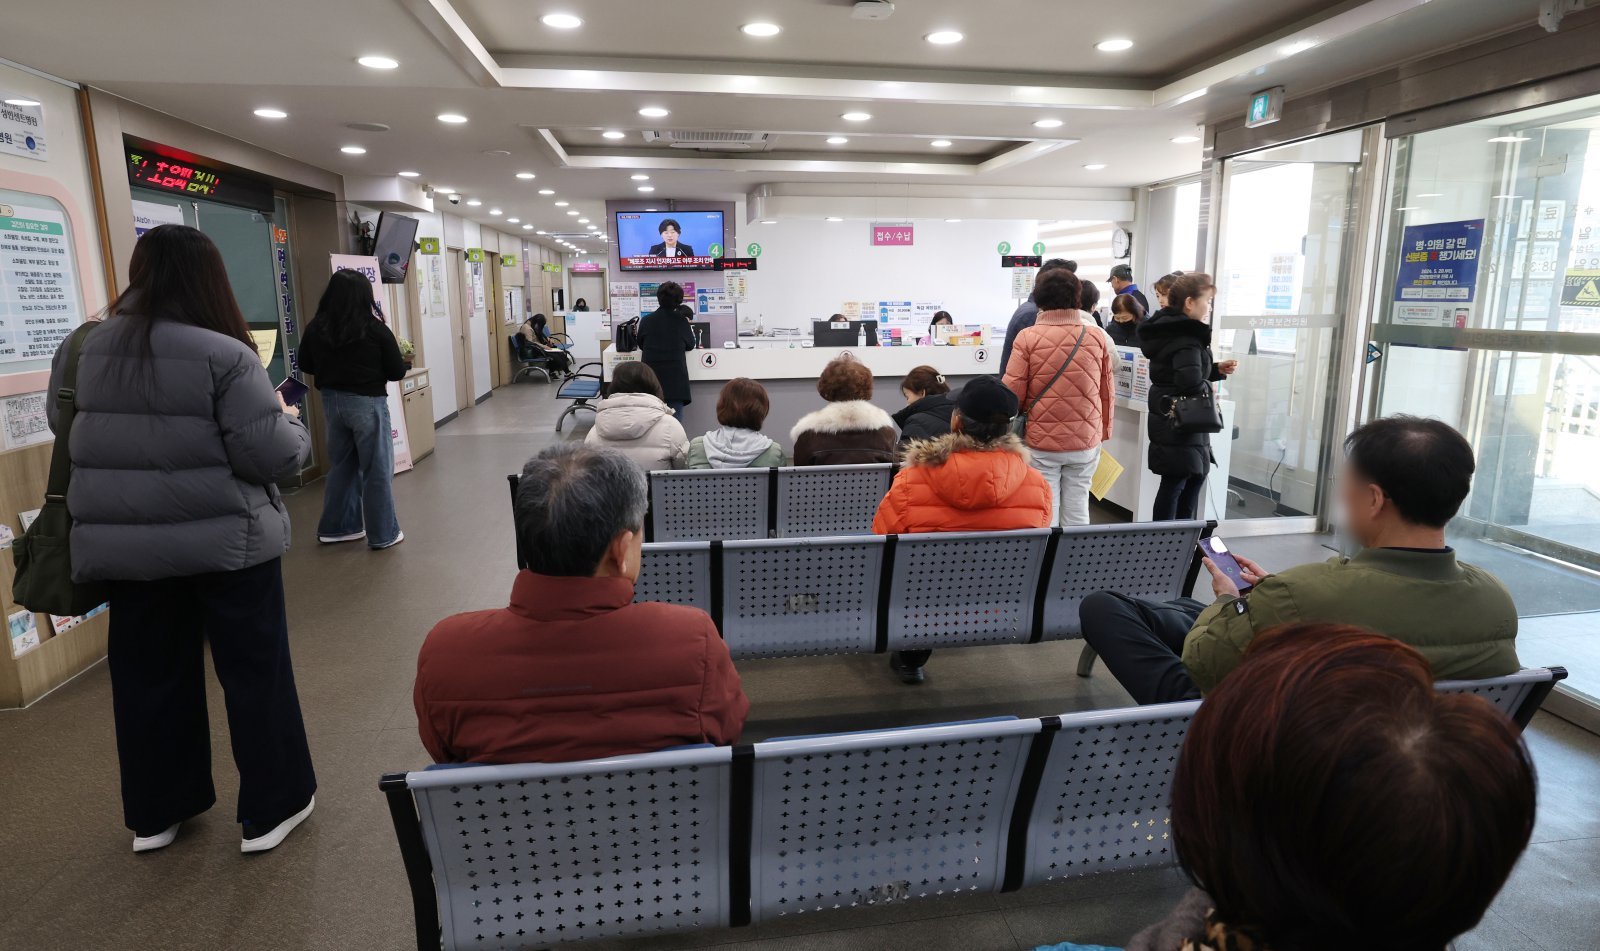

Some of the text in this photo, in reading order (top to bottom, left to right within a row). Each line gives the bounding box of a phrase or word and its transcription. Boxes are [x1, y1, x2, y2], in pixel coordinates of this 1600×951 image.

[1001, 243, 1008, 254] 2
[1416, 239, 1444, 250] 병·의원
[1446, 238, 1456, 249] 갈
[1457, 237, 1467, 249] 땐
[711, 245, 719, 256] 4
[751, 245, 759, 256] 3
[705, 355, 712, 364] 4
[978, 351, 984, 360] 2
